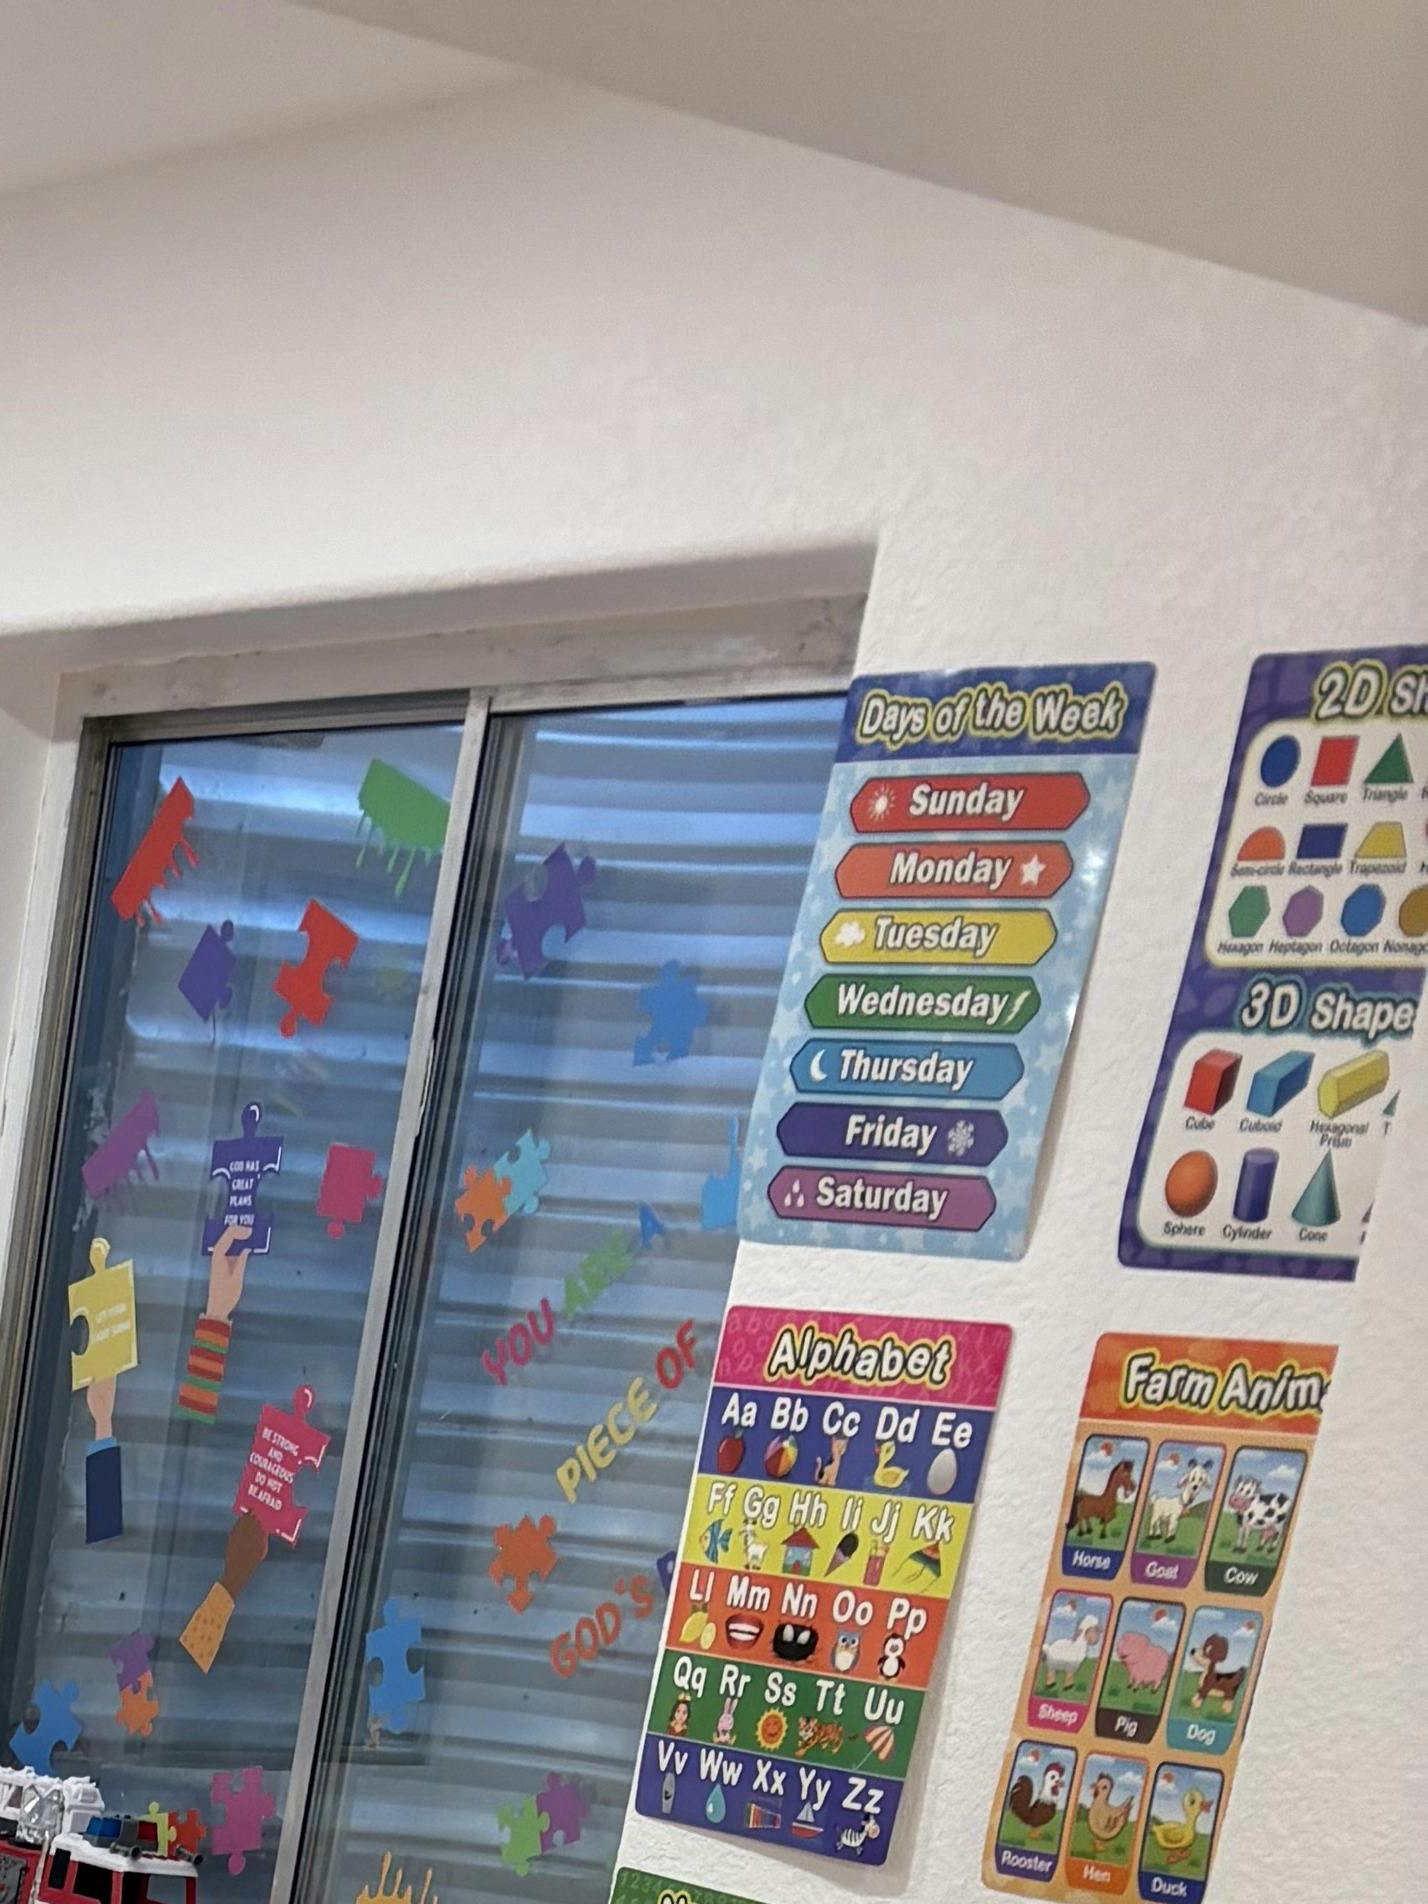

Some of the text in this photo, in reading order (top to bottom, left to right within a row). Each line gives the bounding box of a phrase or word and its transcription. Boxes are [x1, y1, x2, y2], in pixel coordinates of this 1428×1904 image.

[1314, 664, 1384, 720] 2D
[861, 689, 1124, 743] Days of the Week
[909, 783, 1023, 822] Sunday
[890, 853, 1012, 891] Monday
[874, 917, 997, 957] Tuesday
[836, 983, 1009, 1026] Wednesday
[1242, 983, 1416, 1038] 3D Shape
[838, 1049, 974, 1092] Thursday
[845, 1114, 937, 1157] Friday
[816, 1176, 948, 1220] Saturday
[1223, 1224, 1272, 1240] Cylinder
[481, 1298, 554, 1386] YOU
[768, 1325, 952, 1384] Alphabet
[1127, 1353, 1216, 1408] Farm
[556, 1319, 697, 1504] PIECE OF
[721, 1392, 972, 1448] Aa Bb Cc Dd Ee
[549, 1573, 655, 1679] GOD'S
[1037, 1705, 1079, 1726] Sheep
[1186, 1724, 1216, 1745] Dog
[1151, 1877, 1187, 1897] Duck
